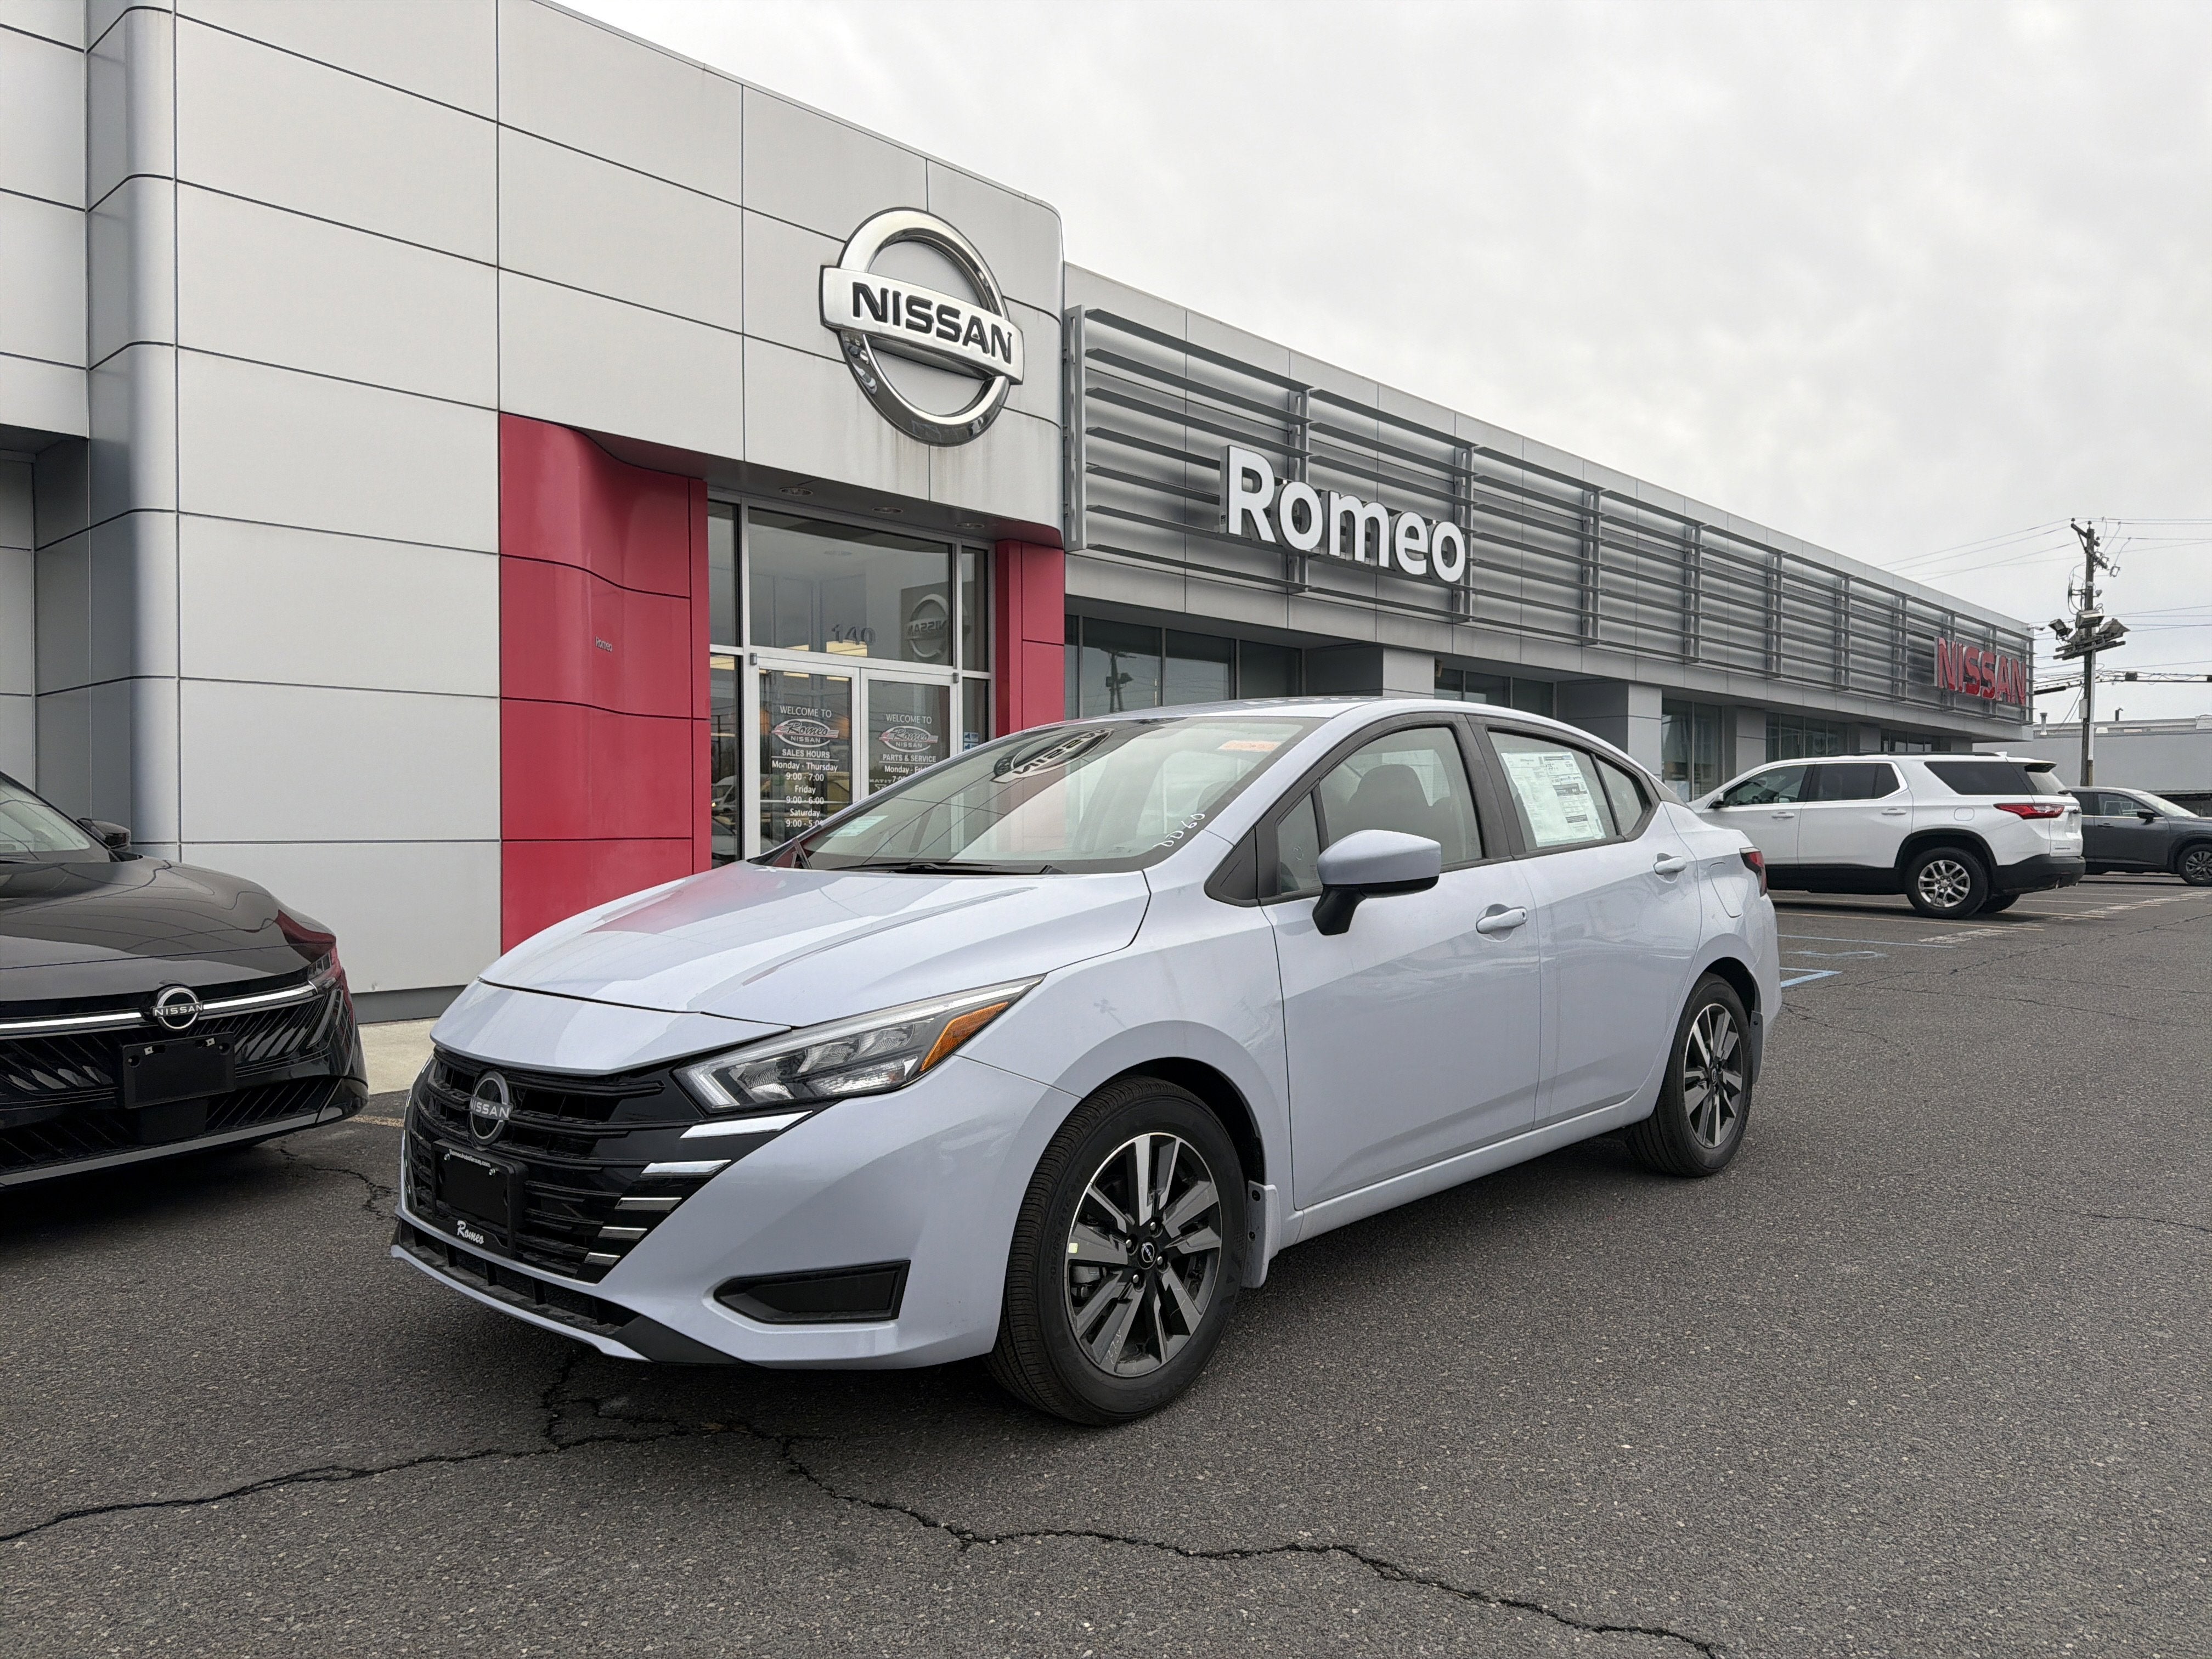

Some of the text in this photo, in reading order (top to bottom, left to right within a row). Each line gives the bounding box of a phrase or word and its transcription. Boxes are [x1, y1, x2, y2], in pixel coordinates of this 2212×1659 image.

[852, 281, 1013, 365] NISSAN
[1220, 444, 1466, 583] Romeo
[831, 624, 876, 645] 140
[1934, 636, 2027, 707] NISSAN
[780, 705, 832, 718] WELCOME TO
[885, 714, 933, 724] WELCOME TO
[784, 720, 828, 736] Romeo
[889, 727, 929, 741] Romeo
[782, 748, 830, 758] SALES HOURS
[771, 760, 800, 771] Monday
[806, 762, 838, 772] Thursday
[884, 765, 910, 775] Monday
[794, 785, 816, 795] Friday
[808, 797, 825, 805] 6:00
[789, 808, 820, 818] Saturday
[154, 1005, 202, 1017] NISSAN
[470, 1098, 510, 1119] NISSAN
[457, 1220, 484, 1244] Romeo
